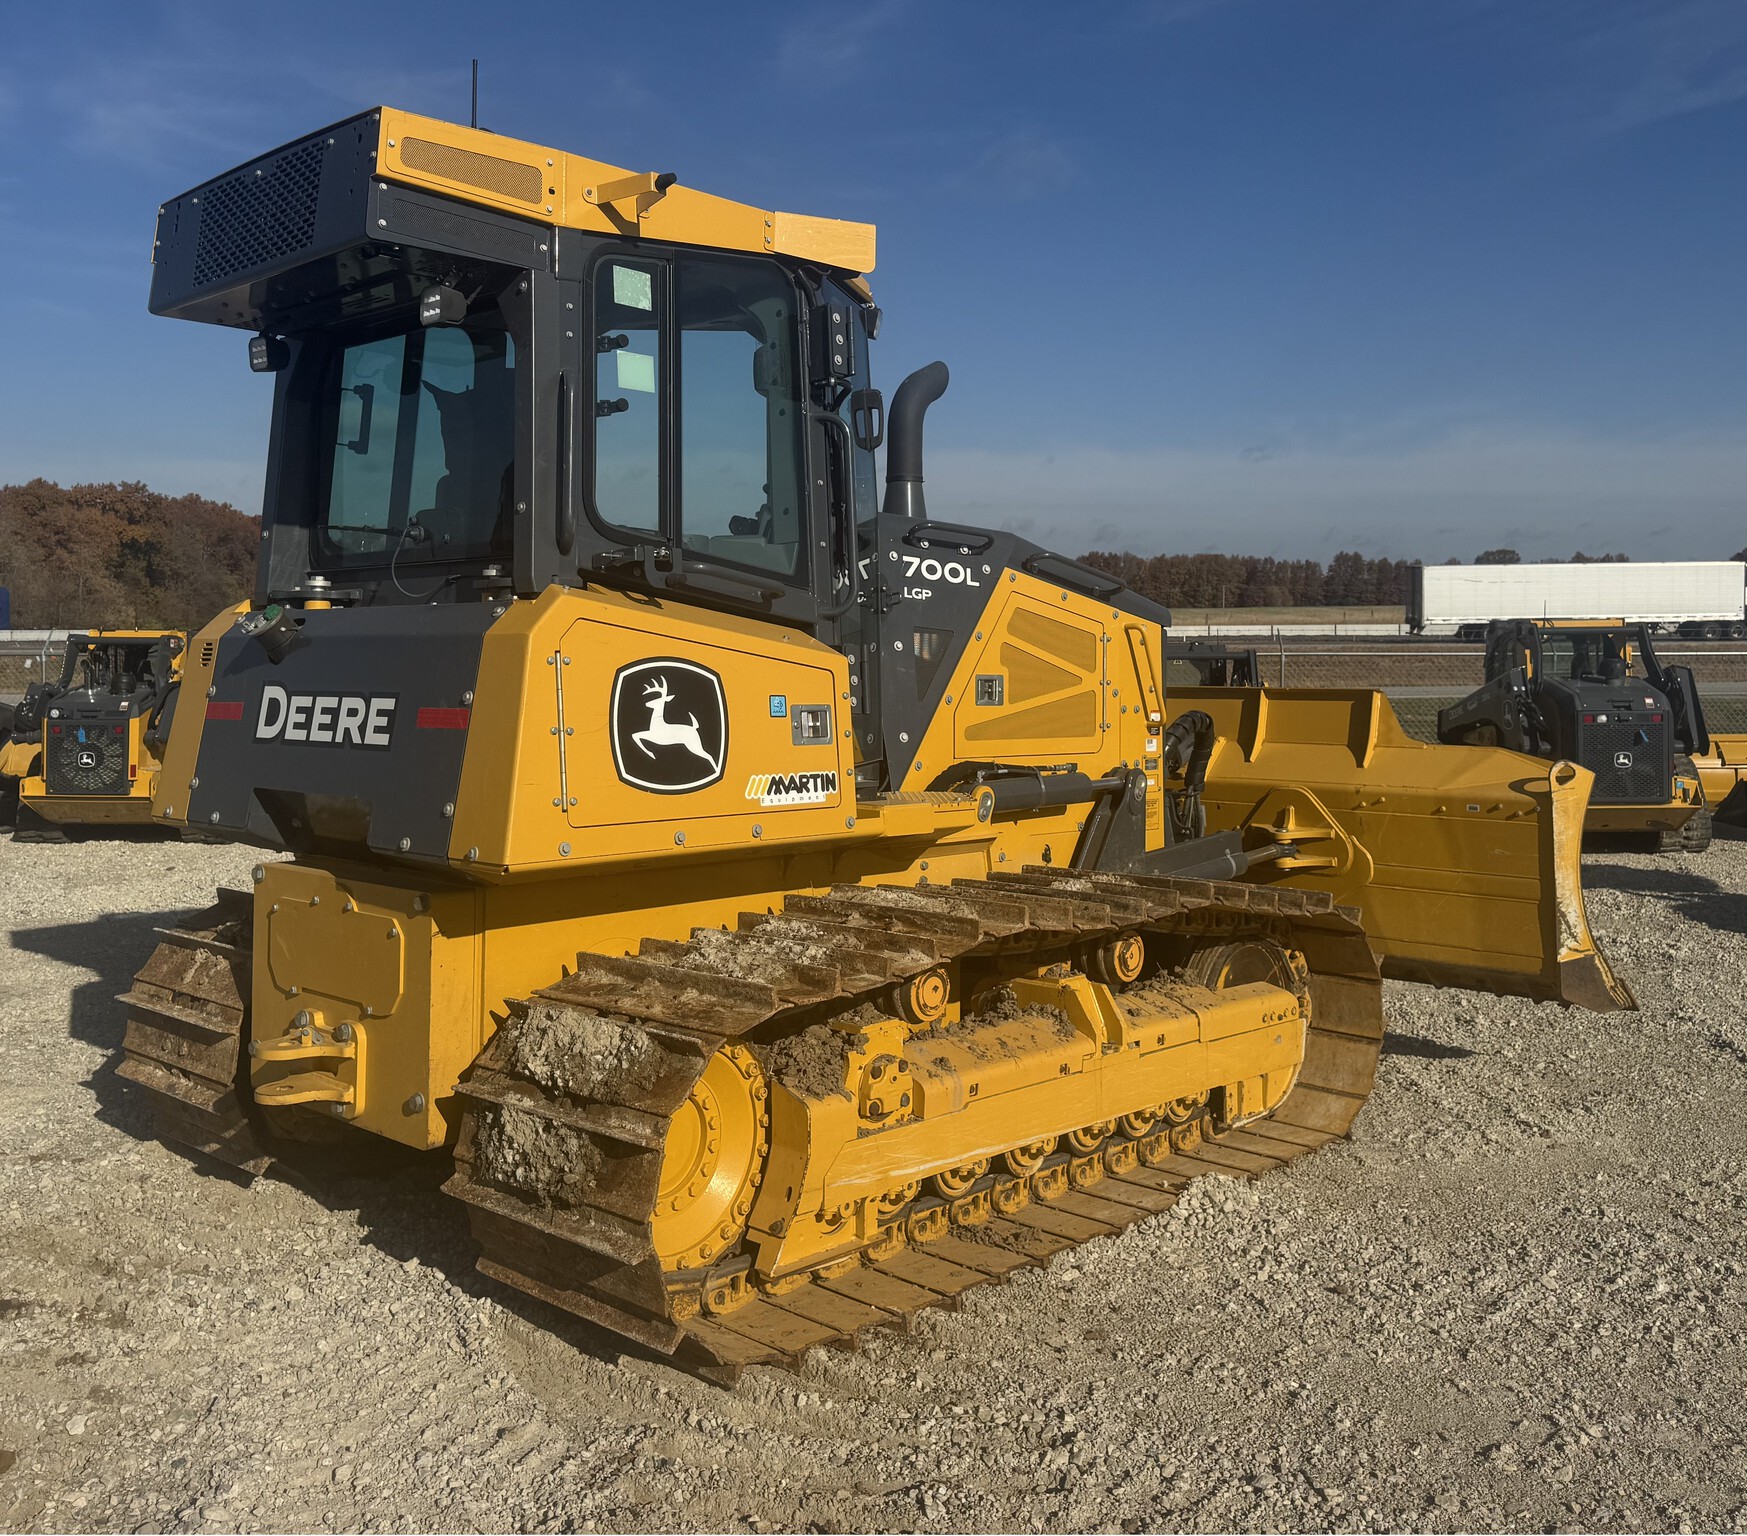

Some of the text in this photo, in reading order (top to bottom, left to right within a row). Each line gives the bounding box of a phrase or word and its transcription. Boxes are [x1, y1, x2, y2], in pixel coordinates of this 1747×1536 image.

[902, 555, 980, 587] 700L
[903, 586, 932, 600] LGP
[256, 685, 396, 746] DEERE
[766, 772, 837, 796] MARTIN
